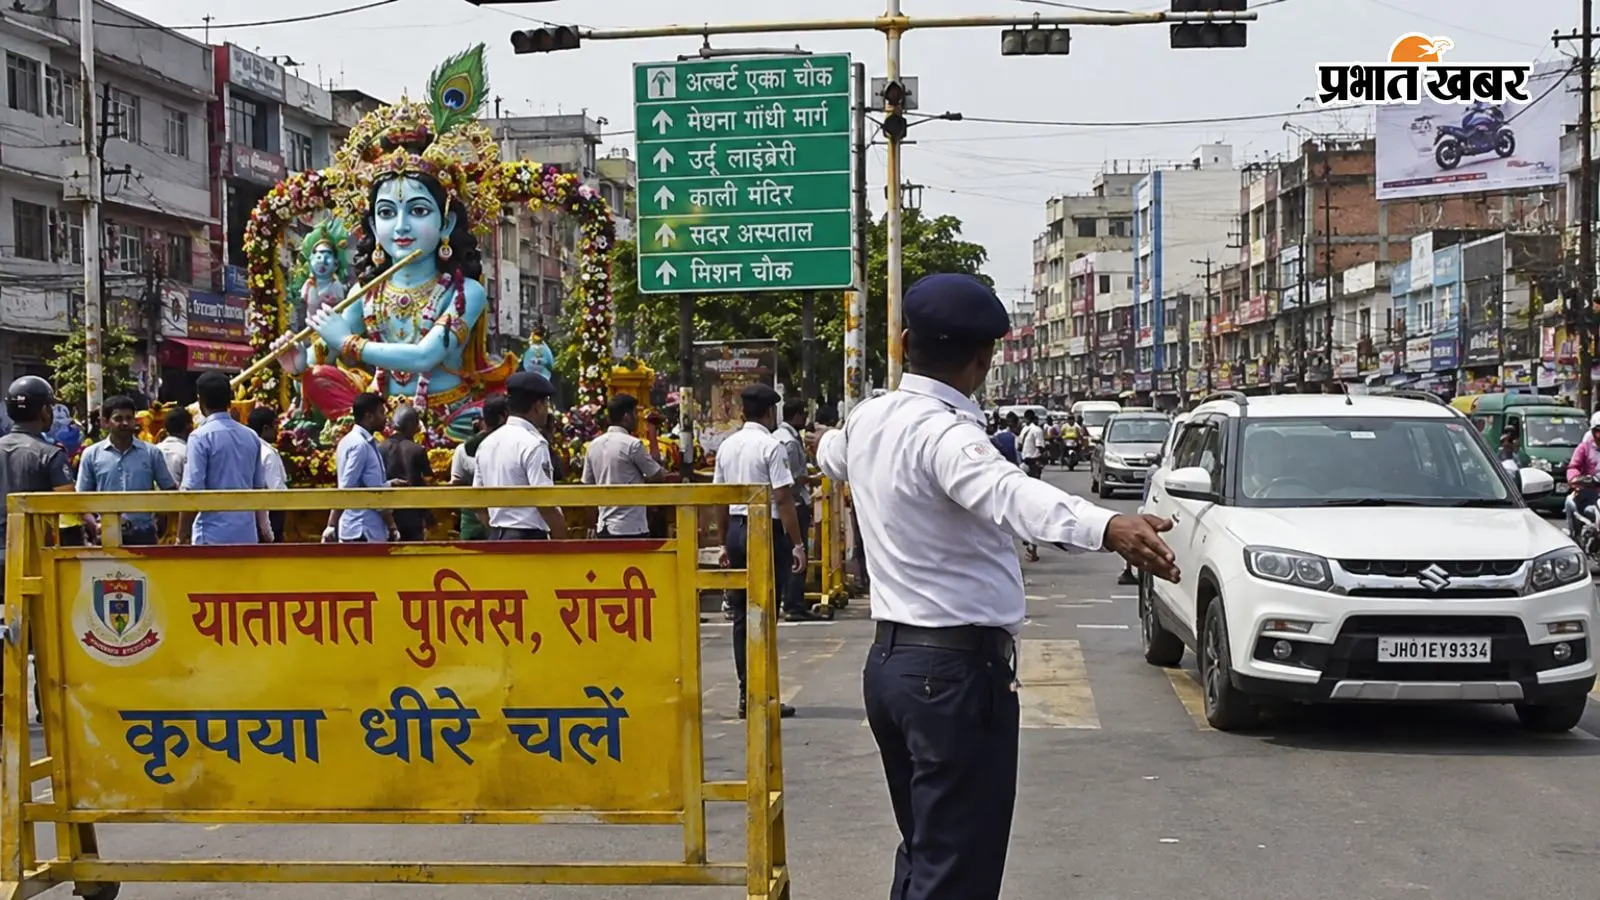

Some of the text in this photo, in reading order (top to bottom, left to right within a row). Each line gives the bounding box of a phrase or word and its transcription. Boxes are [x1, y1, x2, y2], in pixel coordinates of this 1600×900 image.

[686, 59, 833, 95] अल्बर्ट एक्का चौक
[792, 100, 828, 127] मार्ग
[688, 142, 720, 176] उर्दू
[688, 178, 794, 207] काली मंदिर
[688, 222, 814, 245] सदर अस्पताल
[690, 254, 793, 283] मिशन चौक
[187, 566, 657, 669] यातायात पुलिस, रांची
[1388, 641, 1488, 658] JH01EY9334
[119, 686, 630, 785] कृपया धीरे चलें
